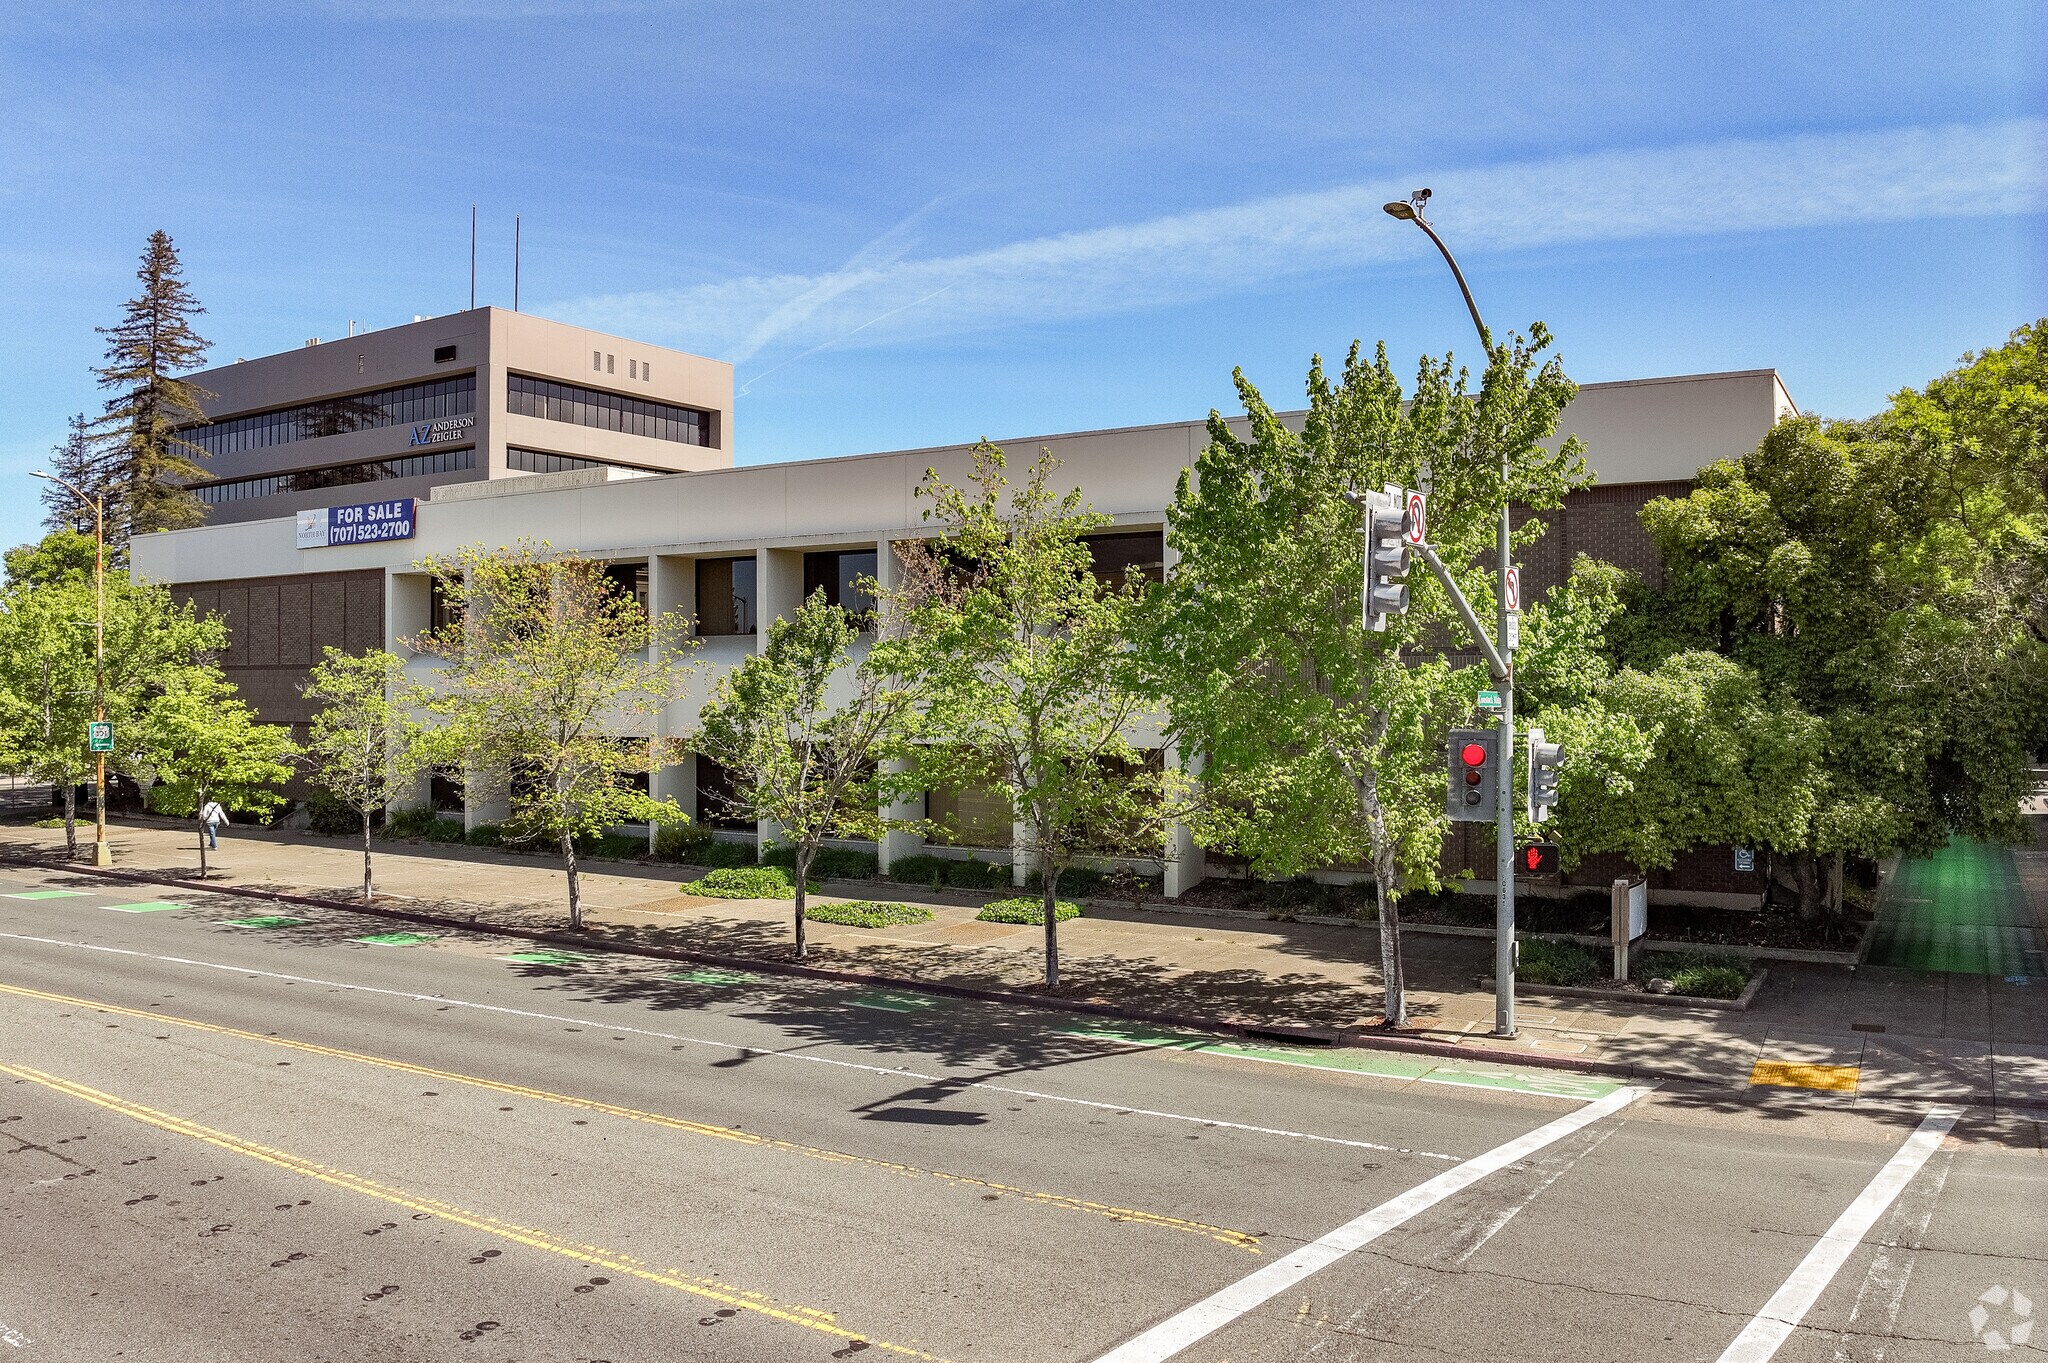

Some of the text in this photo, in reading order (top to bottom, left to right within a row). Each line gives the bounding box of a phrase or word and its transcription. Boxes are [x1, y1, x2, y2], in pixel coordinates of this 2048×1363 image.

[432, 416, 475, 432] ANDERSON
[409, 424, 432, 447] AZ
[431, 430, 463, 443] ZEIGLER
[337, 502, 402, 524] FOR SALE
